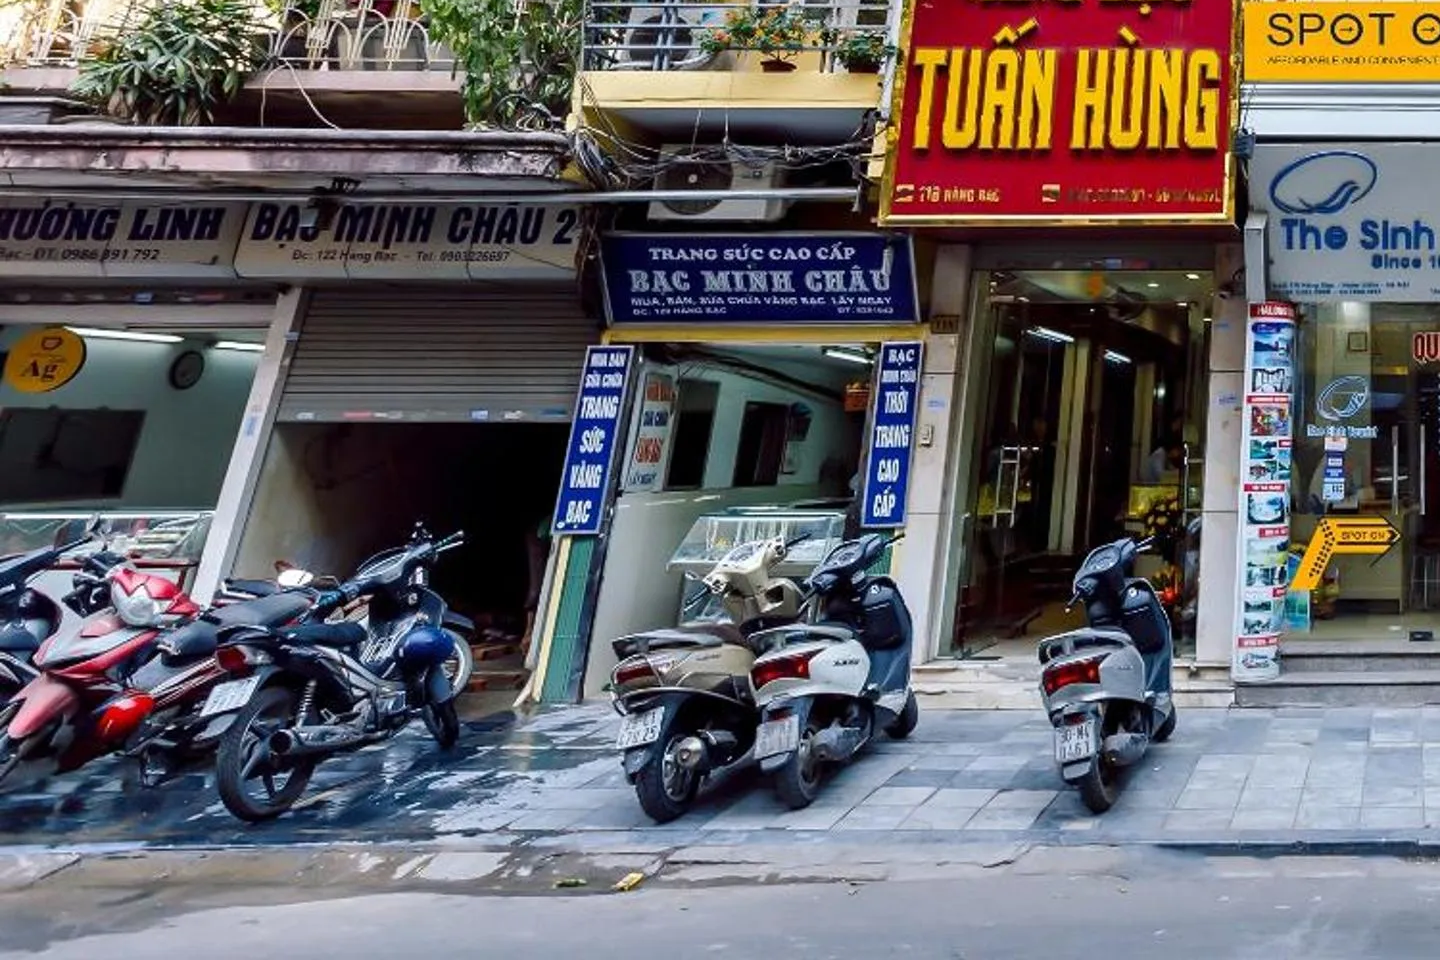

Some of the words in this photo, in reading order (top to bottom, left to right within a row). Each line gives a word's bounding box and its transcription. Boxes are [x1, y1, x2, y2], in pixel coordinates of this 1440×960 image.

[1266, 11, 1396, 46] SPOT
[912, 17, 1057, 152] TUẤN
[1069, 25, 1222, 152] HÙNG
[127, 207, 227, 241] LINH
[552, 207, 578, 245] 2
[1280, 217, 1349, 251] The
[648, 246, 719, 261] TRANG
[723, 243, 765, 261] SỨC
[768, 247, 812, 261] CAO
[815, 241, 857, 261] CẤP
[628, 269, 691, 296] BẠC
[804, 264, 892, 293] CHÂU
[888, 348, 915, 367] BẠC
